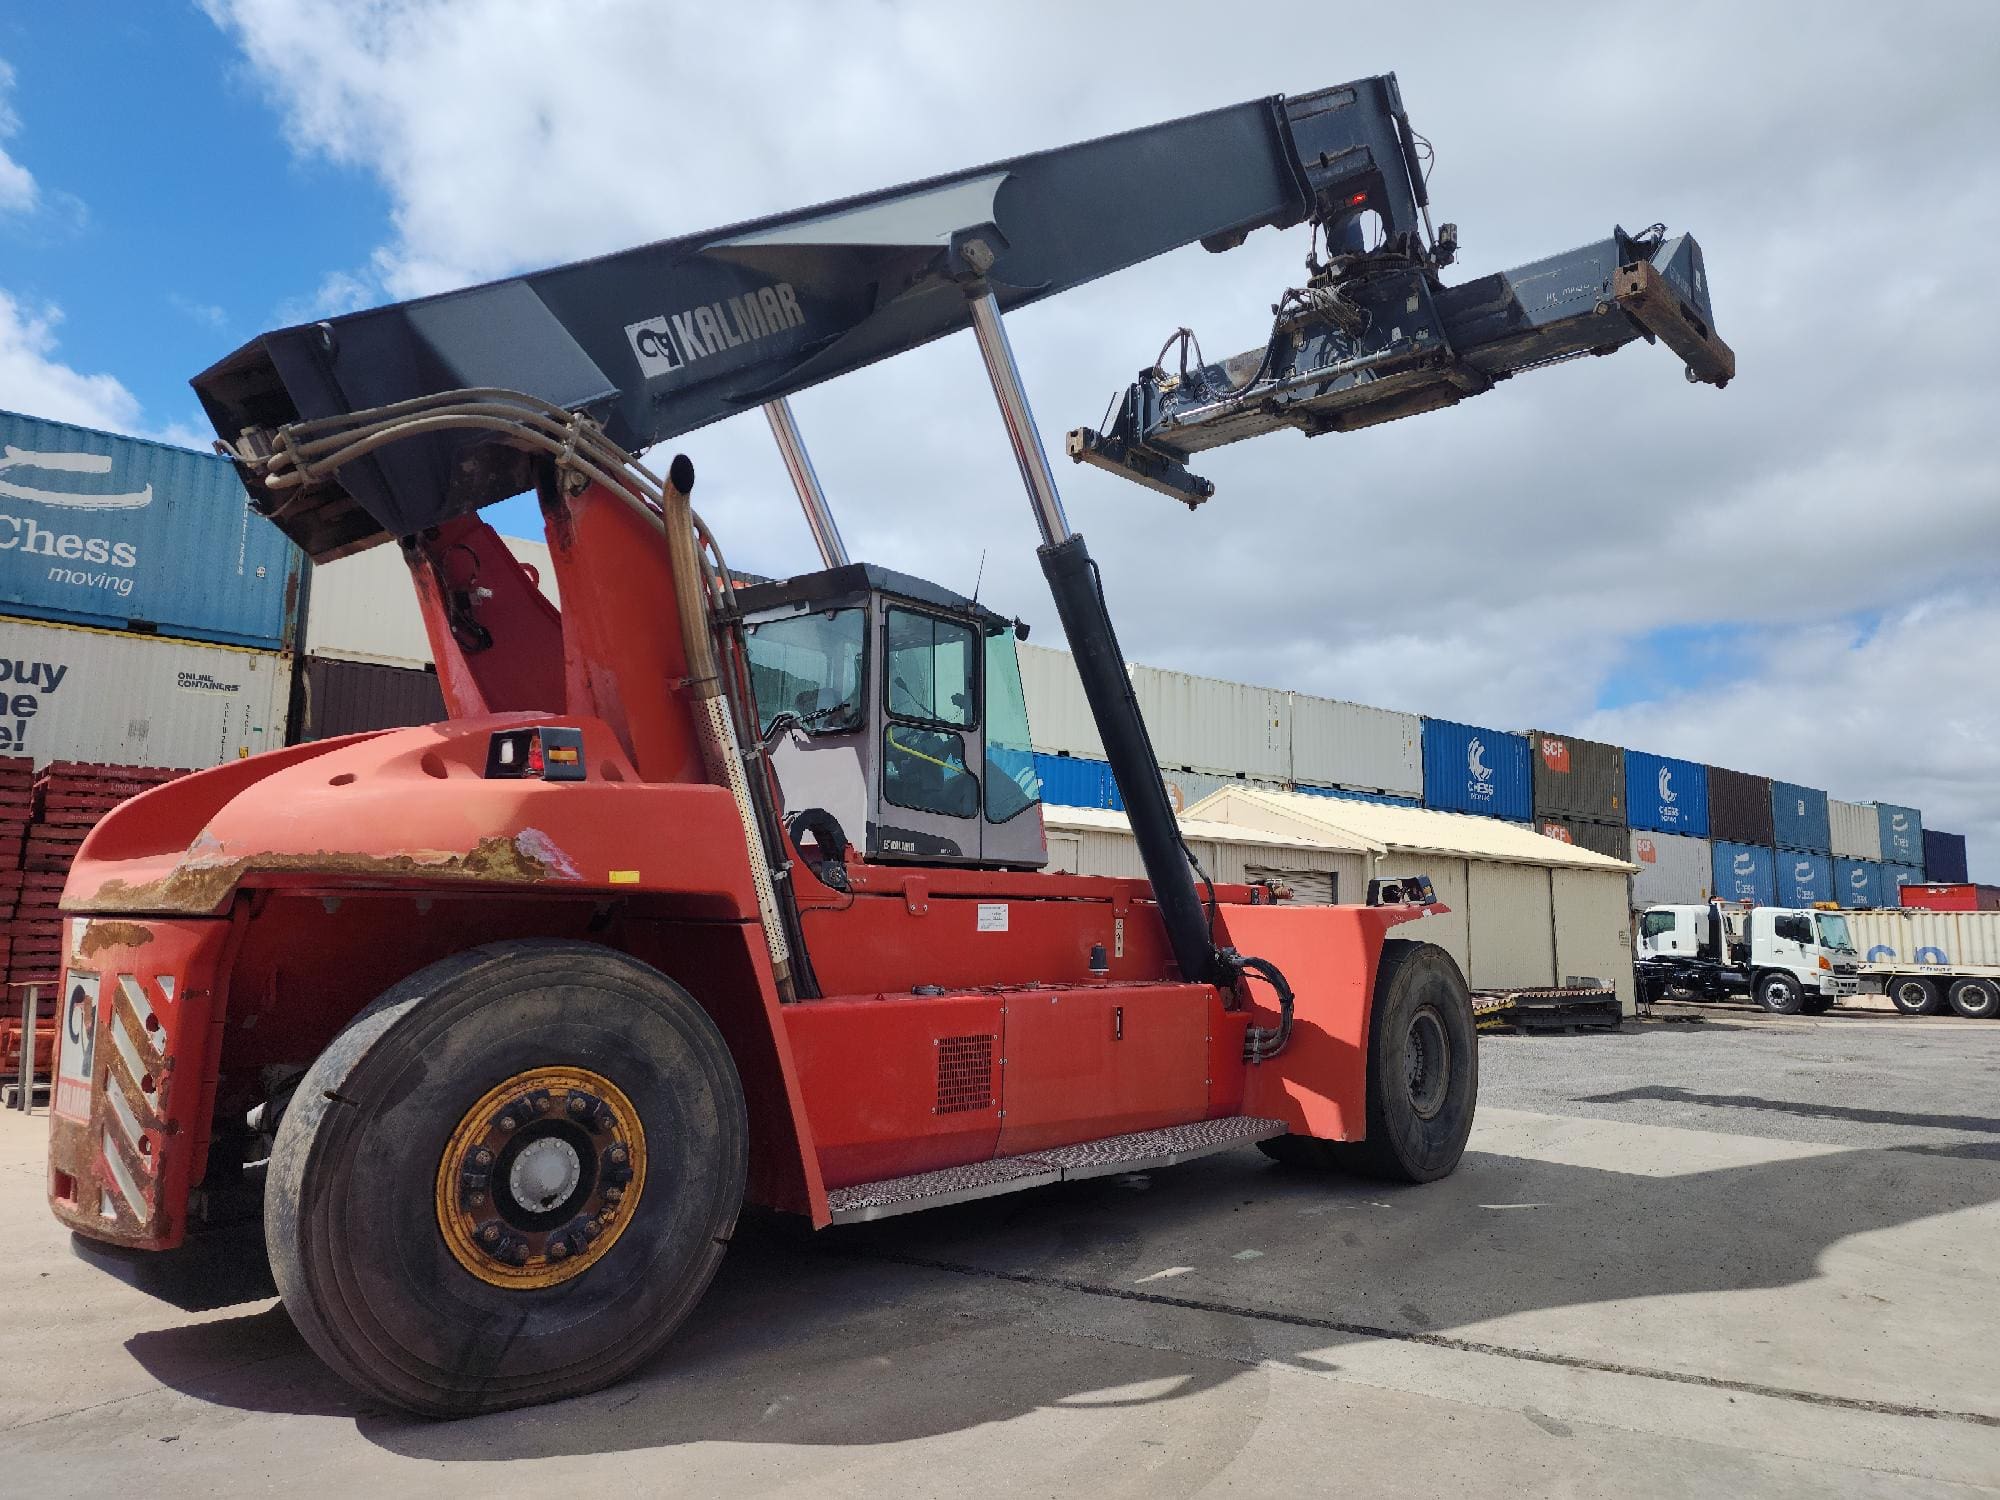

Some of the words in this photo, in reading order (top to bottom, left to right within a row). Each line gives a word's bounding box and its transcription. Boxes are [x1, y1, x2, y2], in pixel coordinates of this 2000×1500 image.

[671, 282, 806, 361] KALMAR
[0, 514, 137, 568] Chess
[48, 567, 134, 597] moving
[178, 672, 214, 682] ONLINE
[178, 680, 241, 692] CONTAINERS
[1543, 740, 1563, 757] SCF
